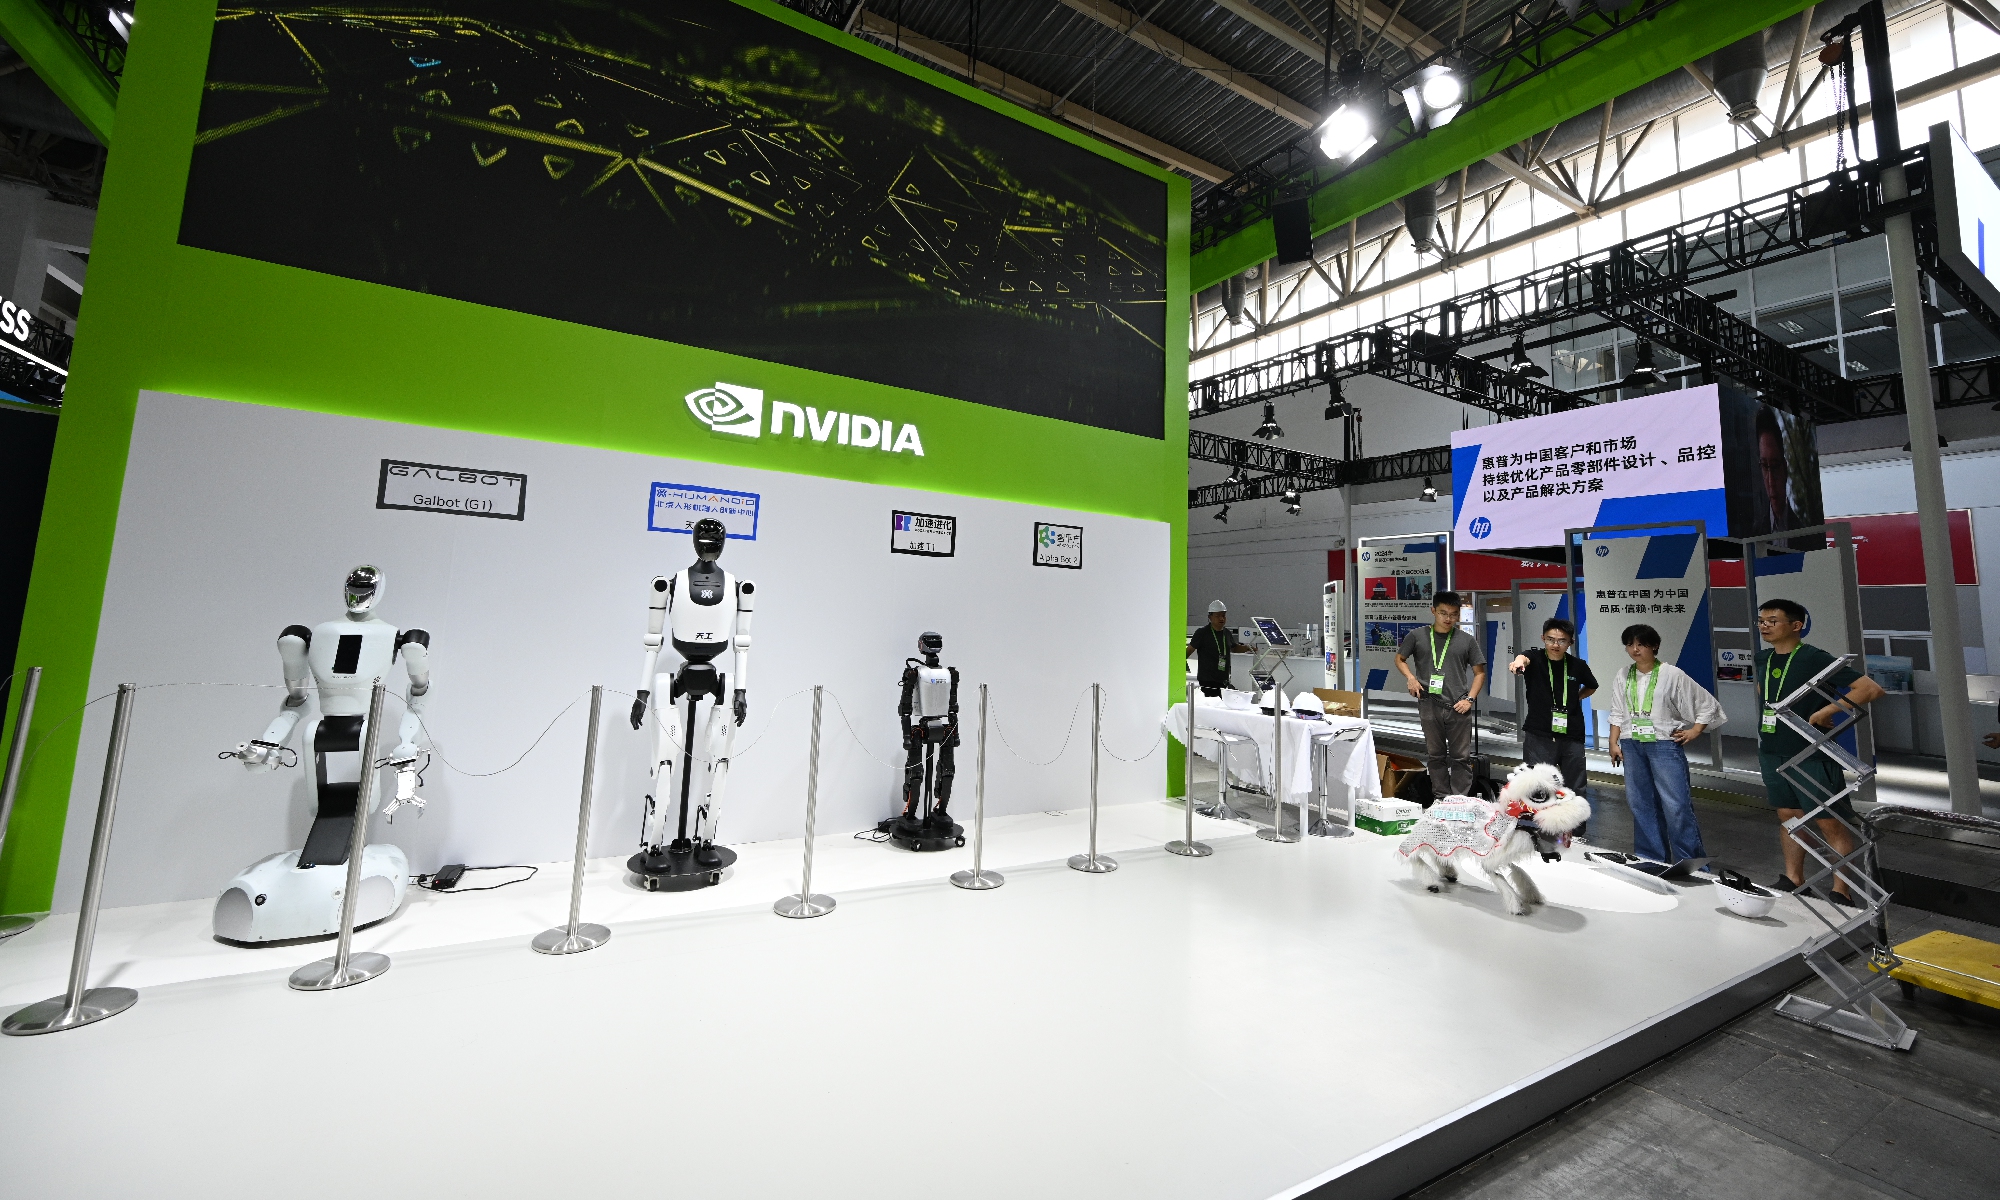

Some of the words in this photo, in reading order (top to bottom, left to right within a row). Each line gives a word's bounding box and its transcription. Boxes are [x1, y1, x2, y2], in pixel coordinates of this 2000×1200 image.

[0, 296, 32, 341] SS
[770, 400, 925, 457] NVIDIA
[1482, 435, 1637, 470] 惠普为中国客户和市场
[389, 465, 521, 487] GALBOT
[1482, 444, 1717, 486] 持续优化产品零部件设计、品控
[1483, 478, 1604, 502] 以及产品解决方案
[413, 494, 461, 508] Galbot
[464, 498, 492, 511] (G1)
[914, 517, 952, 531] 加速进化
[1470, 518, 1491, 539] hp
[695, 632, 713, 640] 天工
